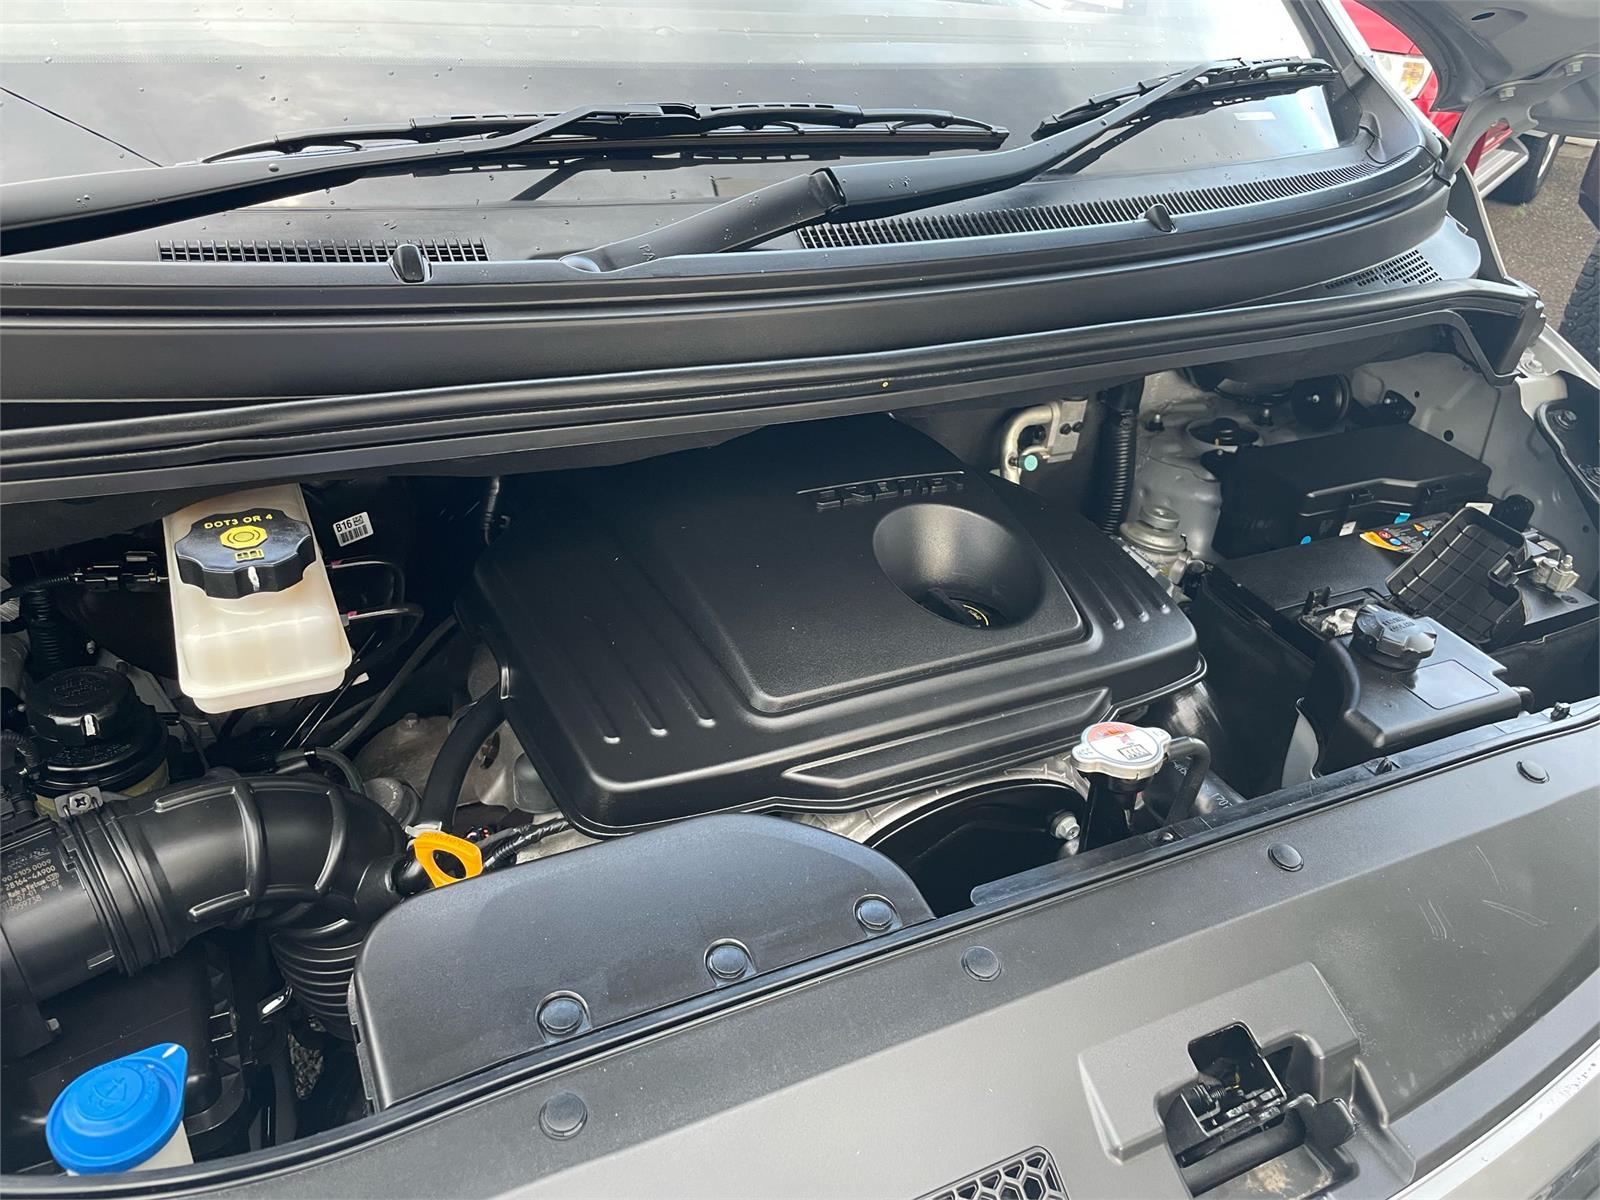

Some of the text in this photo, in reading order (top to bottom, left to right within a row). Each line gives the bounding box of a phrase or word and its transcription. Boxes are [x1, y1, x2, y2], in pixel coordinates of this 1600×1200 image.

[203, 513, 273, 529] DOT3 OR 4
[335, 519, 354, 533] B16
[4, 865, 56, 891] 28164-4A900
